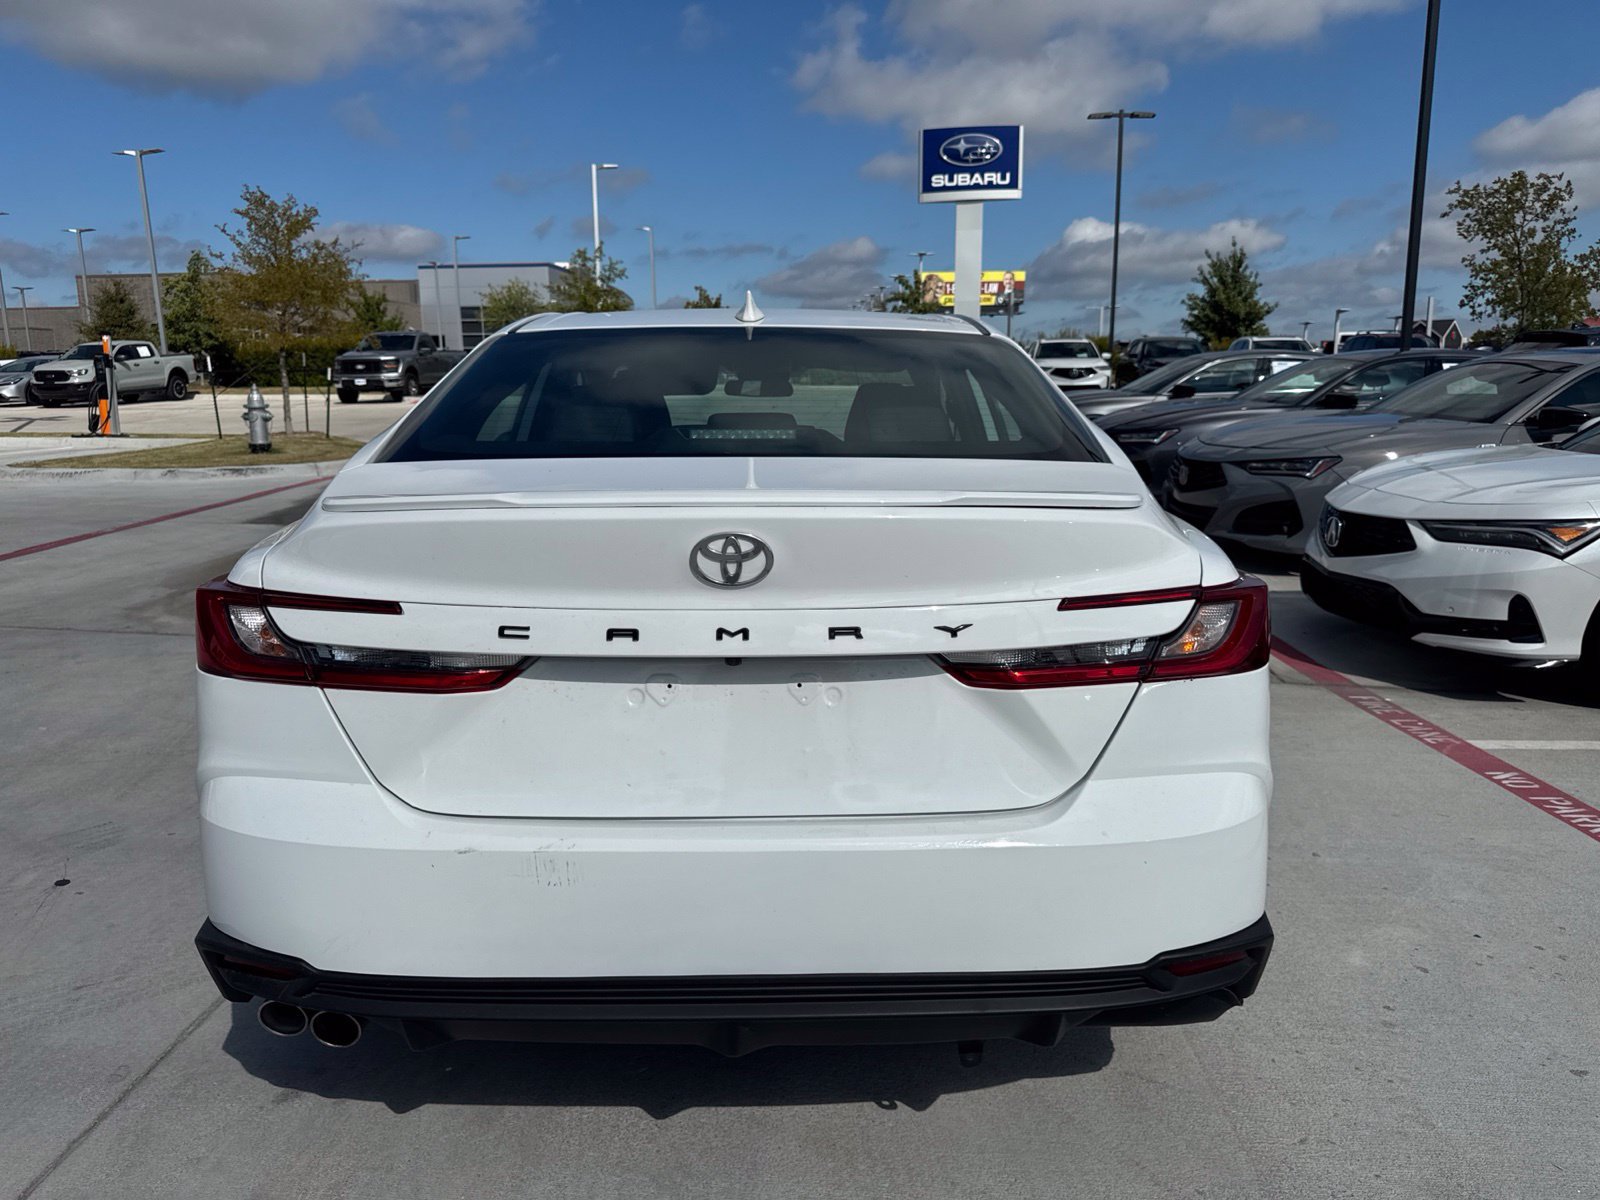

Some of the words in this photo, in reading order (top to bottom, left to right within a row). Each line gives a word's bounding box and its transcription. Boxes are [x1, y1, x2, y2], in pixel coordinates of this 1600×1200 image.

[931, 172, 1011, 187] SUBARU
[498, 623, 974, 642] CAMRY
[1348, 695, 1407, 714] FIRE
[1390, 719, 1461, 744] LANE
[1484, 771, 1539, 788] NO
